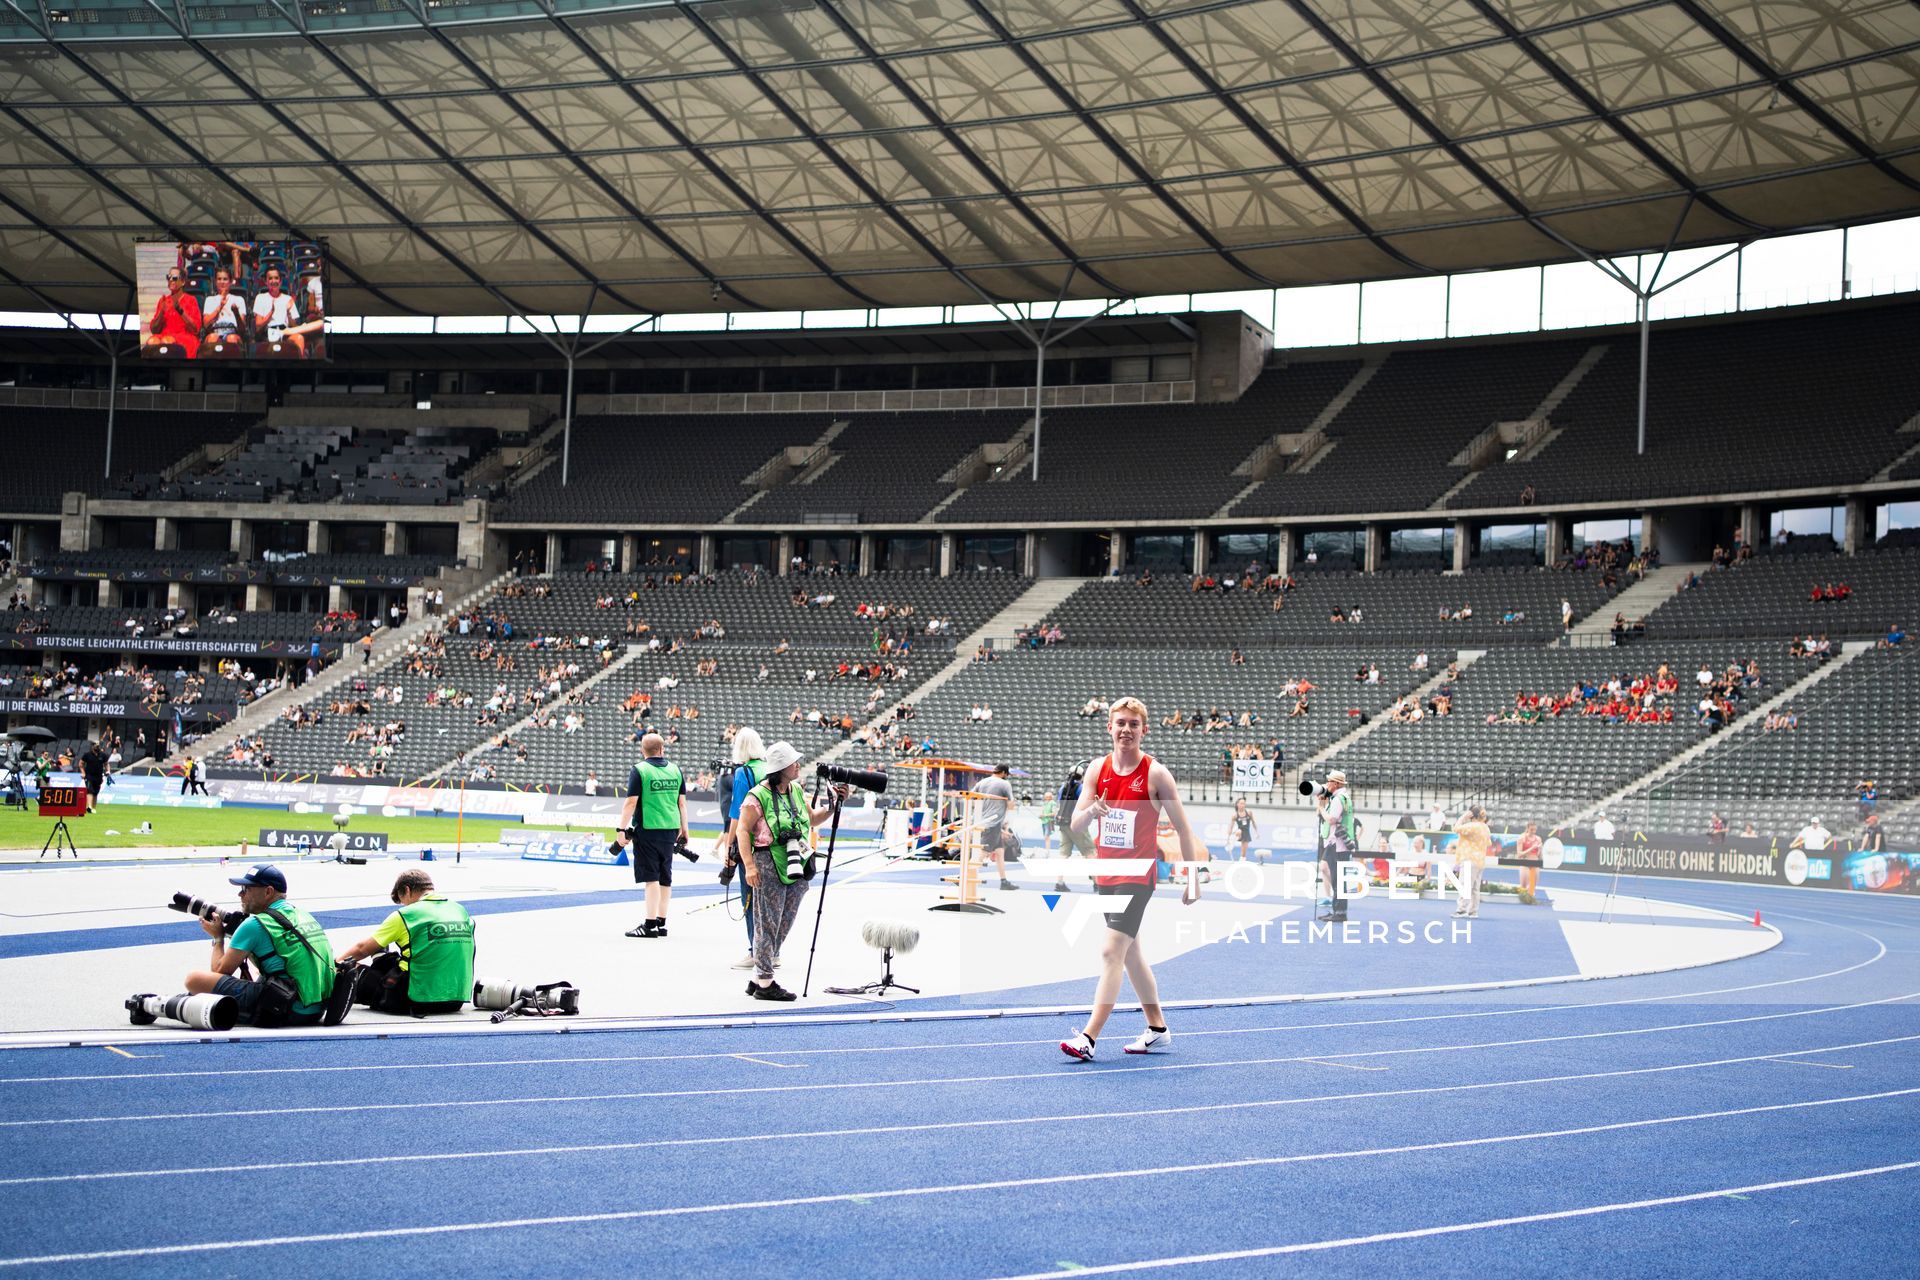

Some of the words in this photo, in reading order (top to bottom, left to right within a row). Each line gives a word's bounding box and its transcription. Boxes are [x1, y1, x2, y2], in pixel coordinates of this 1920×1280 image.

[36, 636, 85, 648] DEUTSCHE
[88, 637, 257, 653] LEICHTATHLETIK-MEISTERSCHAFTEN
[12, 701, 27, 711] DIE
[28, 701, 60, 712] FINALS
[70, 702, 101, 714] BERLIN
[103, 704, 125, 715] 2022
[43, 789, 73, 804] 5:00
[1105, 822, 1127, 834] FINKE
[1679, 850, 1715, 873] OHNE
[1718, 848, 1777, 877] HÜRDEN.
